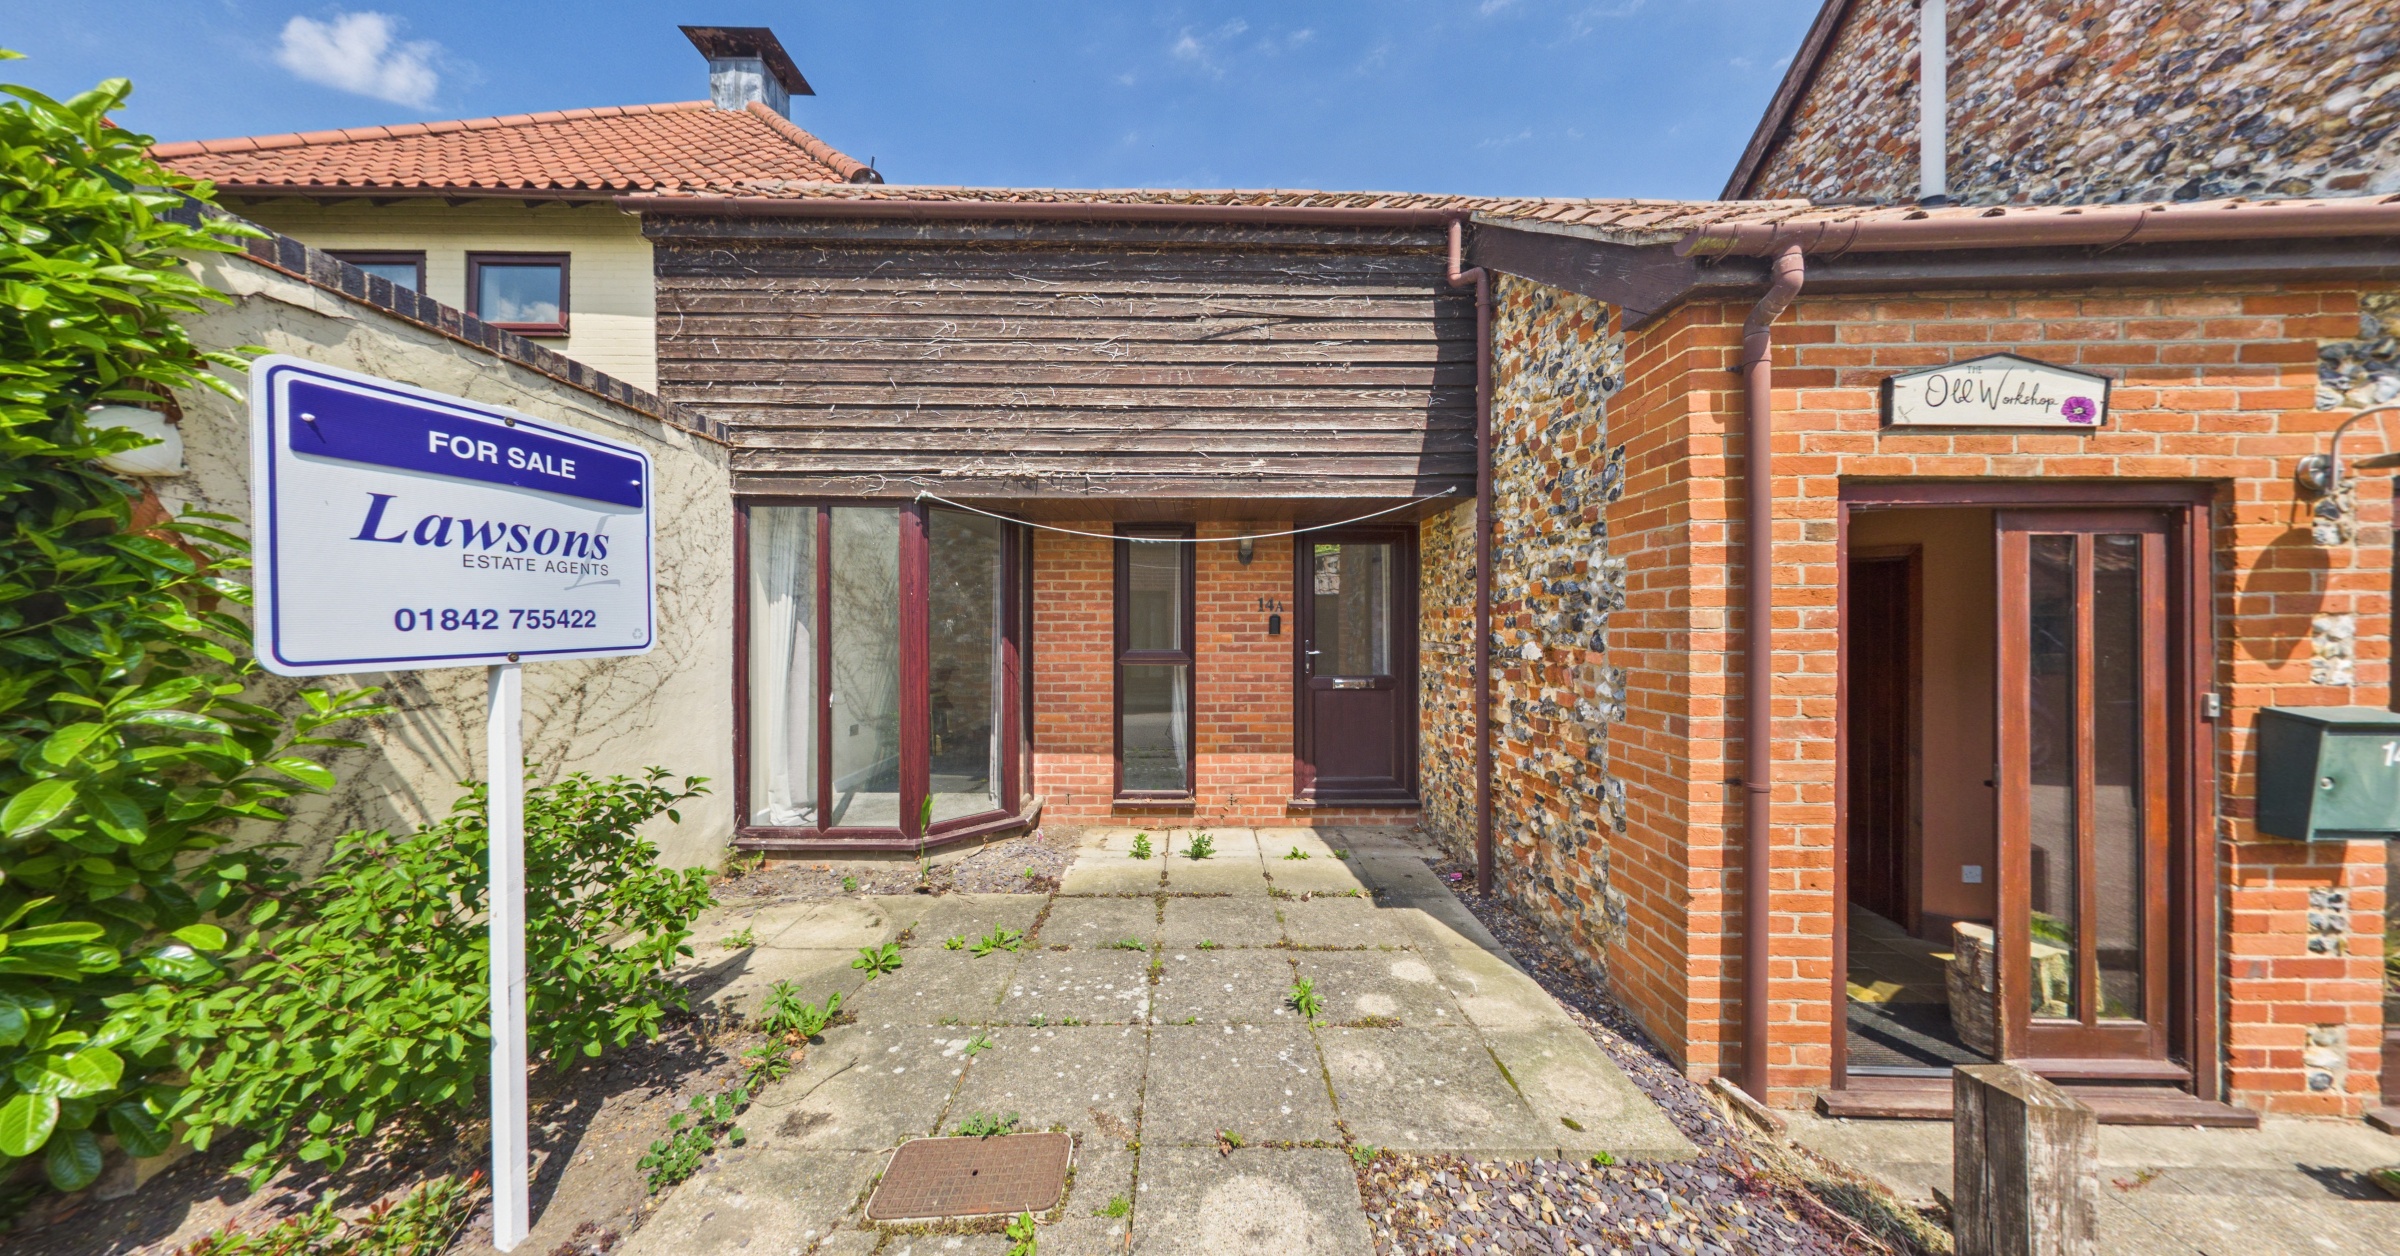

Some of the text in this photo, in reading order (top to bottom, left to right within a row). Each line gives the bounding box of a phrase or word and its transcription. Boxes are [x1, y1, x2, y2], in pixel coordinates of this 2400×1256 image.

[1967, 365, 1983, 374] THE
[1925, 365, 2060, 413] Old Workshop
[428, 430, 576, 480] FOR SALE
[350, 492, 610, 562] Lawsons
[463, 554, 609, 576] ESTATE AGENTS
[1257, 597, 1284, 613] 14A
[394, 608, 597, 632] 01842 755422
